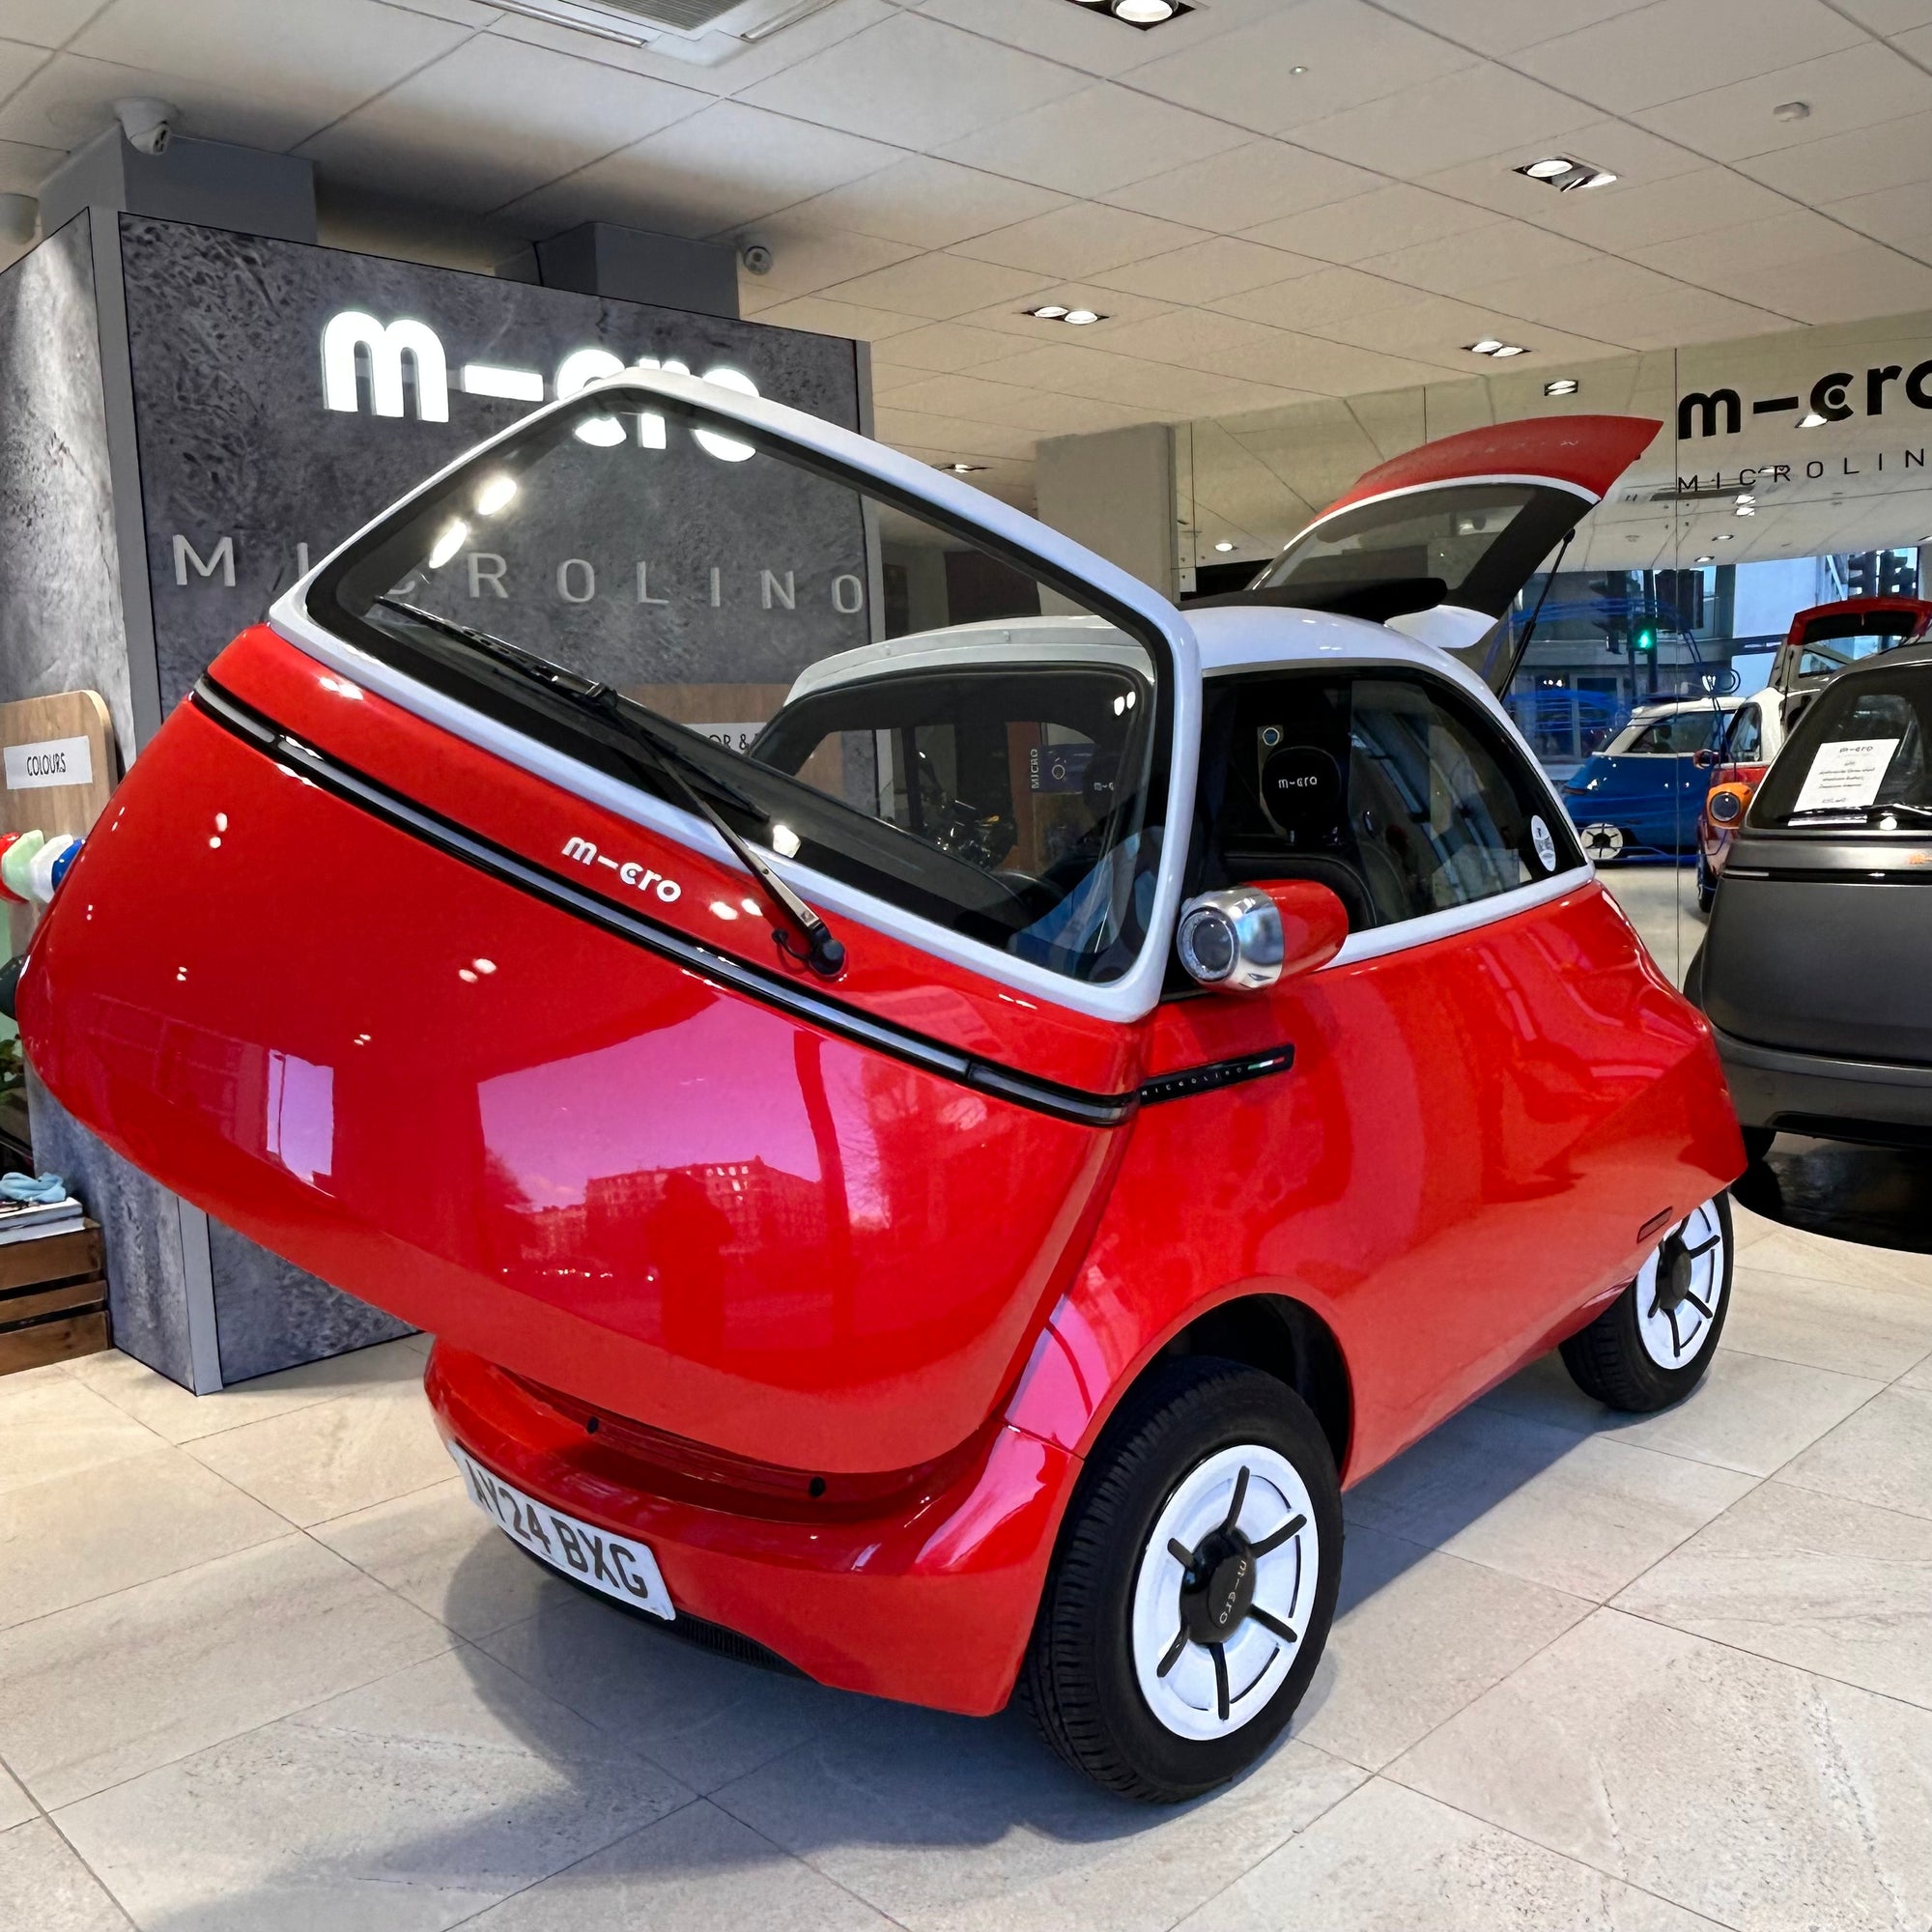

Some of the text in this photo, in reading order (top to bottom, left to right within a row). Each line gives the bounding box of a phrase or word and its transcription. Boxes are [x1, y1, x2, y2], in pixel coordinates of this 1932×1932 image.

[173, 534, 863, 613] MIROLINO
[26, 752, 67, 777] COLOURS
[550, 1516, 649, 1599] BXG
